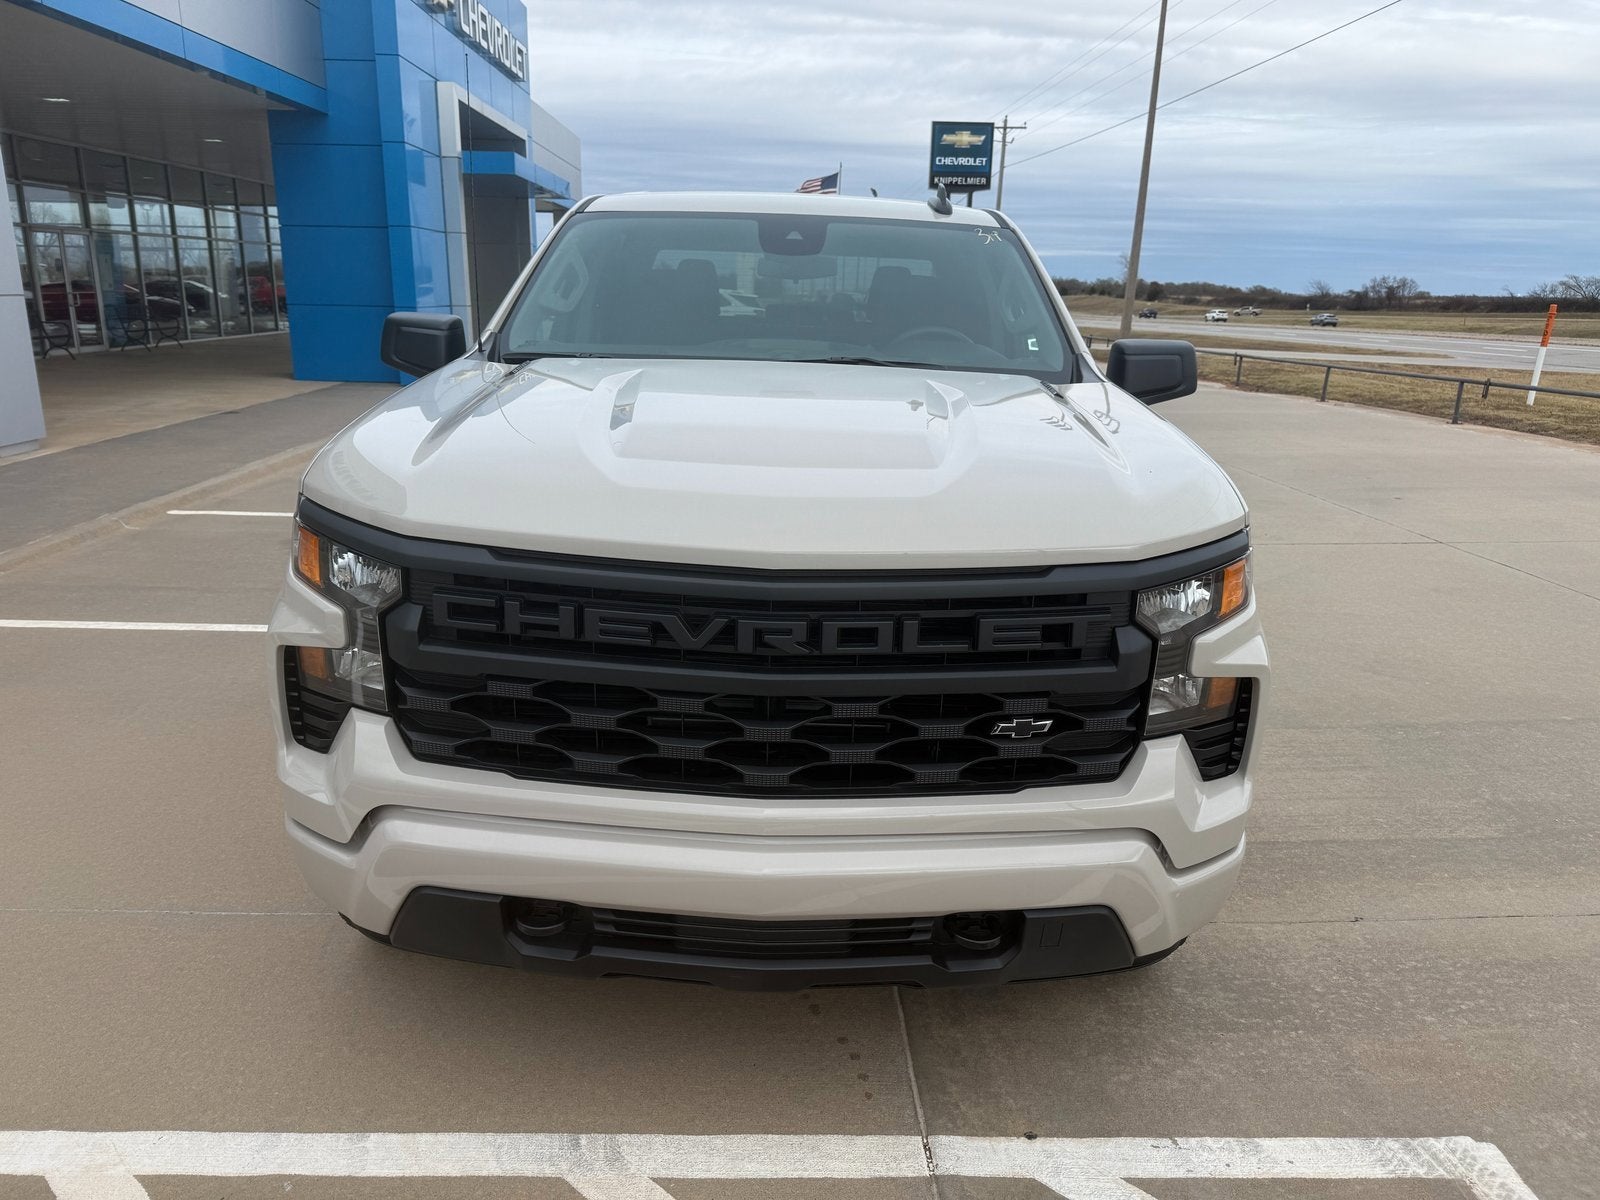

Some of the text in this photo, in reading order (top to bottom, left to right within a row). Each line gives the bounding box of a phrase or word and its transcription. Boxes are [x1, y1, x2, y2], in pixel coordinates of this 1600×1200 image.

[459, 0, 527, 82] CHEVROLET
[936, 157, 987, 166] CHEVROLET
[934, 176, 987, 185] KNIPPELMIER
[432, 592, 1113, 655] CHEVROLET
